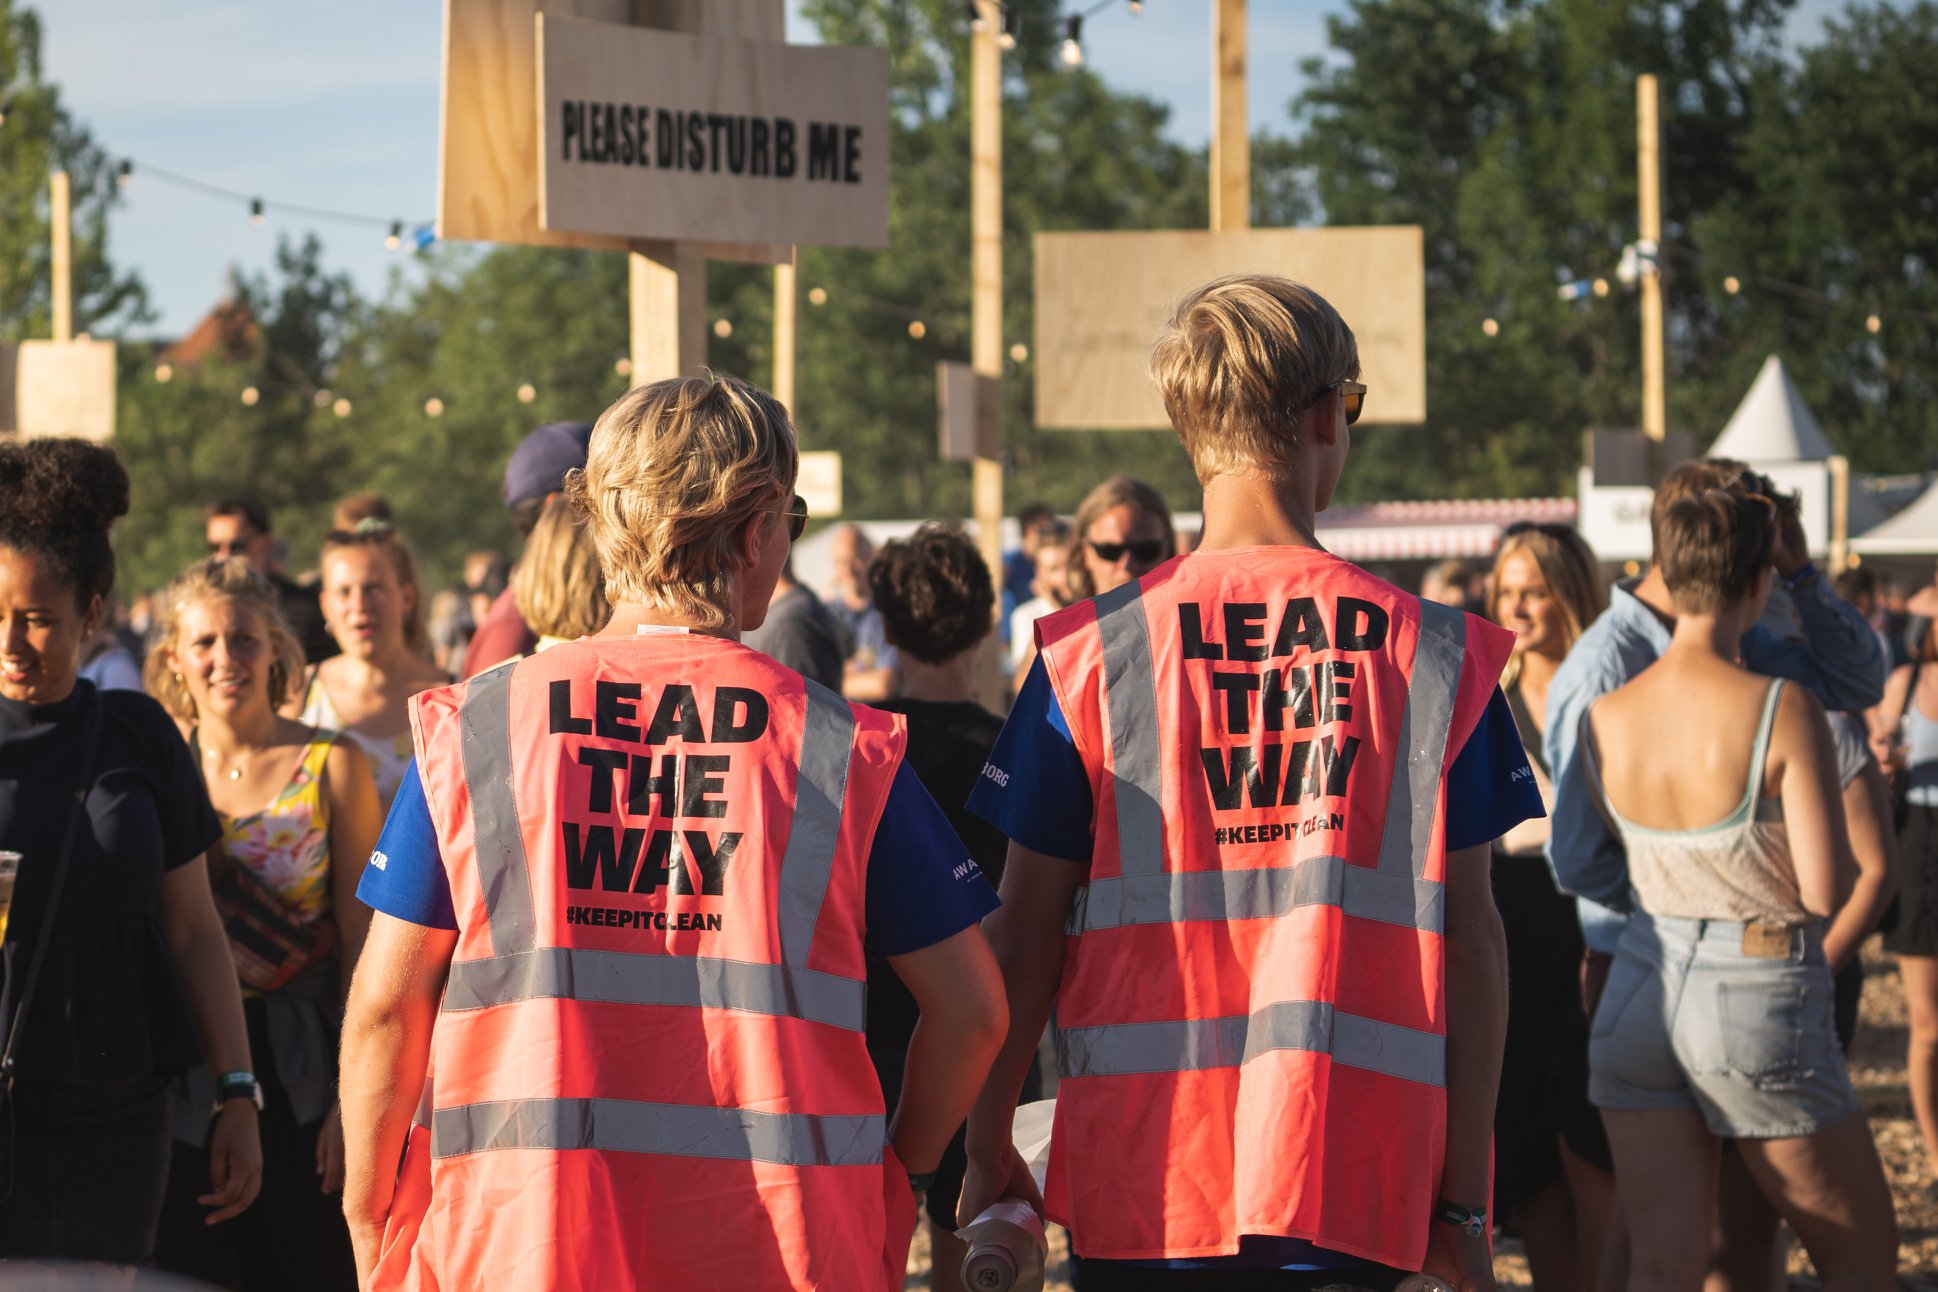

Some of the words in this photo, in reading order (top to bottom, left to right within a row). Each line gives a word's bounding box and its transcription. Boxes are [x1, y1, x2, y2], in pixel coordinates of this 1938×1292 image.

[561, 100, 650, 167] PLEASE
[656, 107, 797, 178] DISTURB
[807, 121, 862, 184] ME
[1178, 596, 1389, 662] LEAD
[549, 679, 769, 745] LEAD
[1213, 661, 1355, 734] THE
[579, 746, 730, 818] THE
[1201, 734, 1361, 810] WAY
[562, 821, 744, 896] WAY
[1215, 813, 1344, 845] #KEEPITCLEAN
[567, 906, 722, 931] #KEEPITCLEAN
